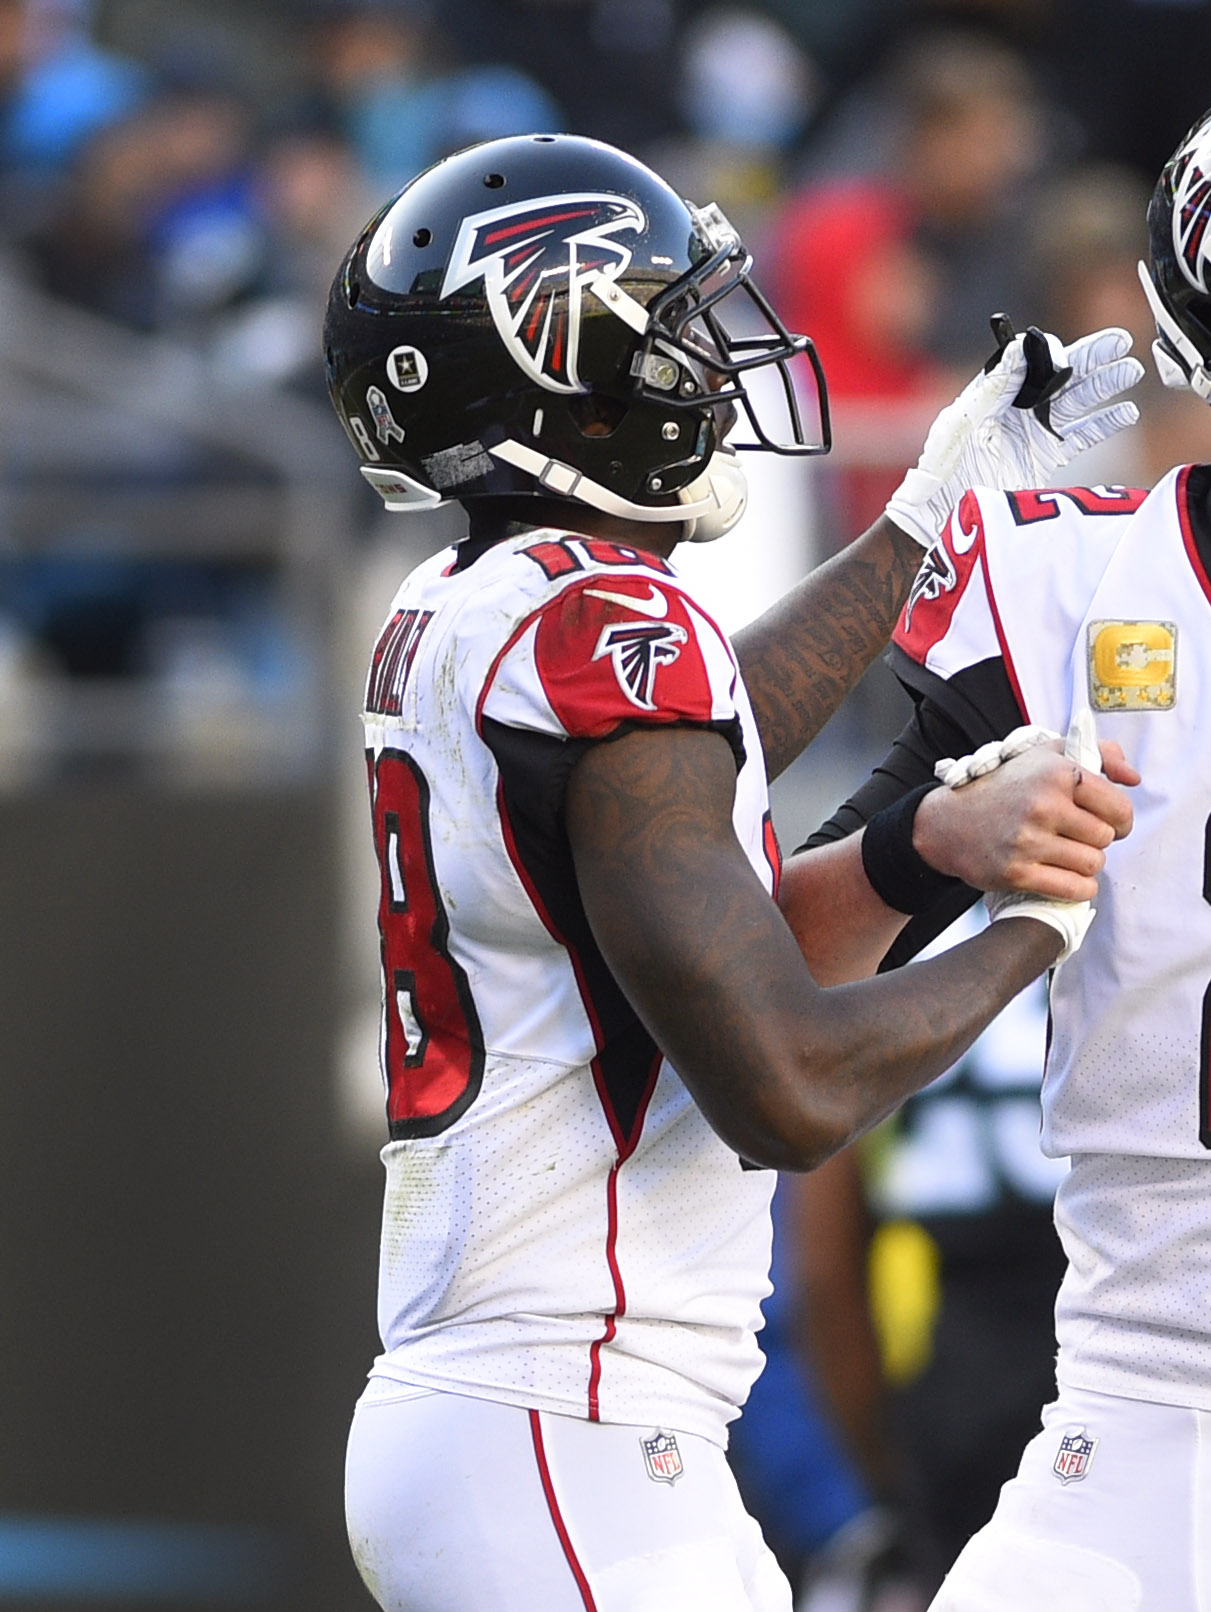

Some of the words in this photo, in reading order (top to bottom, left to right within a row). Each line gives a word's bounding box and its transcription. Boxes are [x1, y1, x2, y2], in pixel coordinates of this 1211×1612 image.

[1003, 486, 1151, 526] 2
[1095, 625, 1171, 686] C
[366, 747, 486, 1140] 8
[652, 1452, 681, 1475] NFL
[1057, 1452, 1084, 1475] NFL
